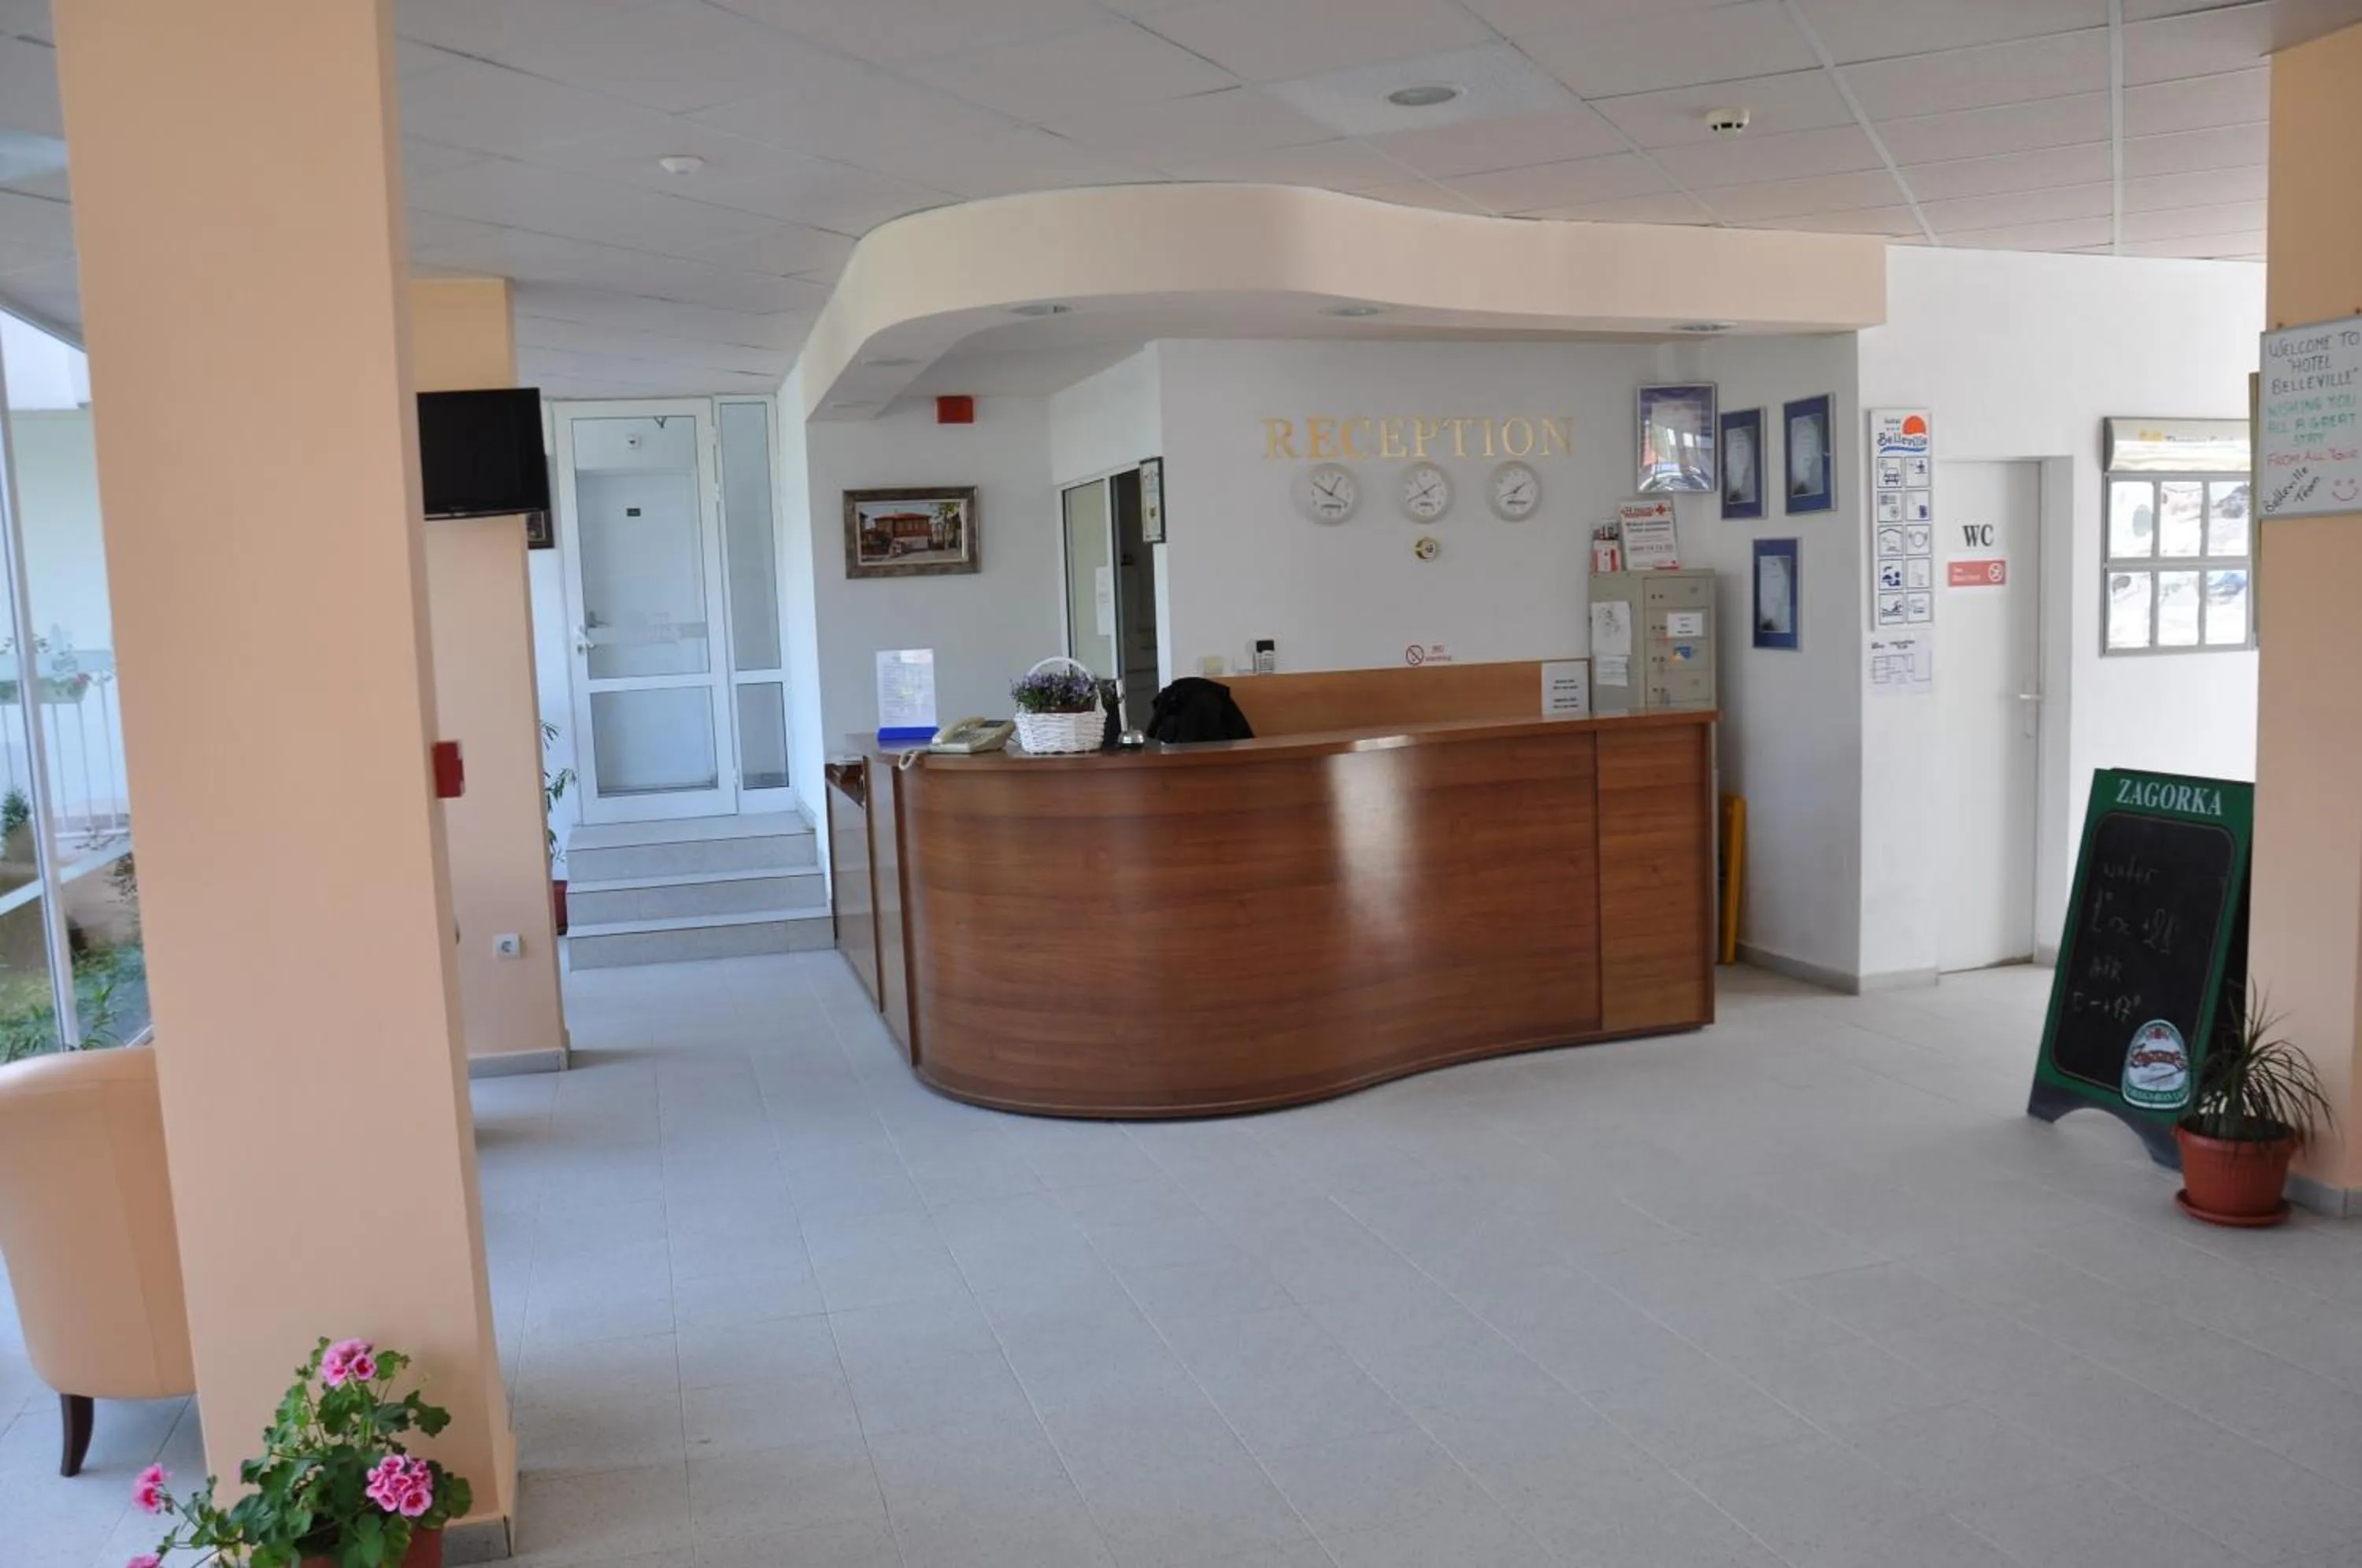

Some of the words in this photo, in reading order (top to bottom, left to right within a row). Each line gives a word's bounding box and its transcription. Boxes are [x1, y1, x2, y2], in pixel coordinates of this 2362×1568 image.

[2268, 335, 2332, 358] WELCOME
[2338, 331, 2360, 348] TO
[1260, 416, 1574, 459] RECEPTION
[1963, 523, 1994, 547] WC
[2116, 778, 2222, 816] ZAGORKA
